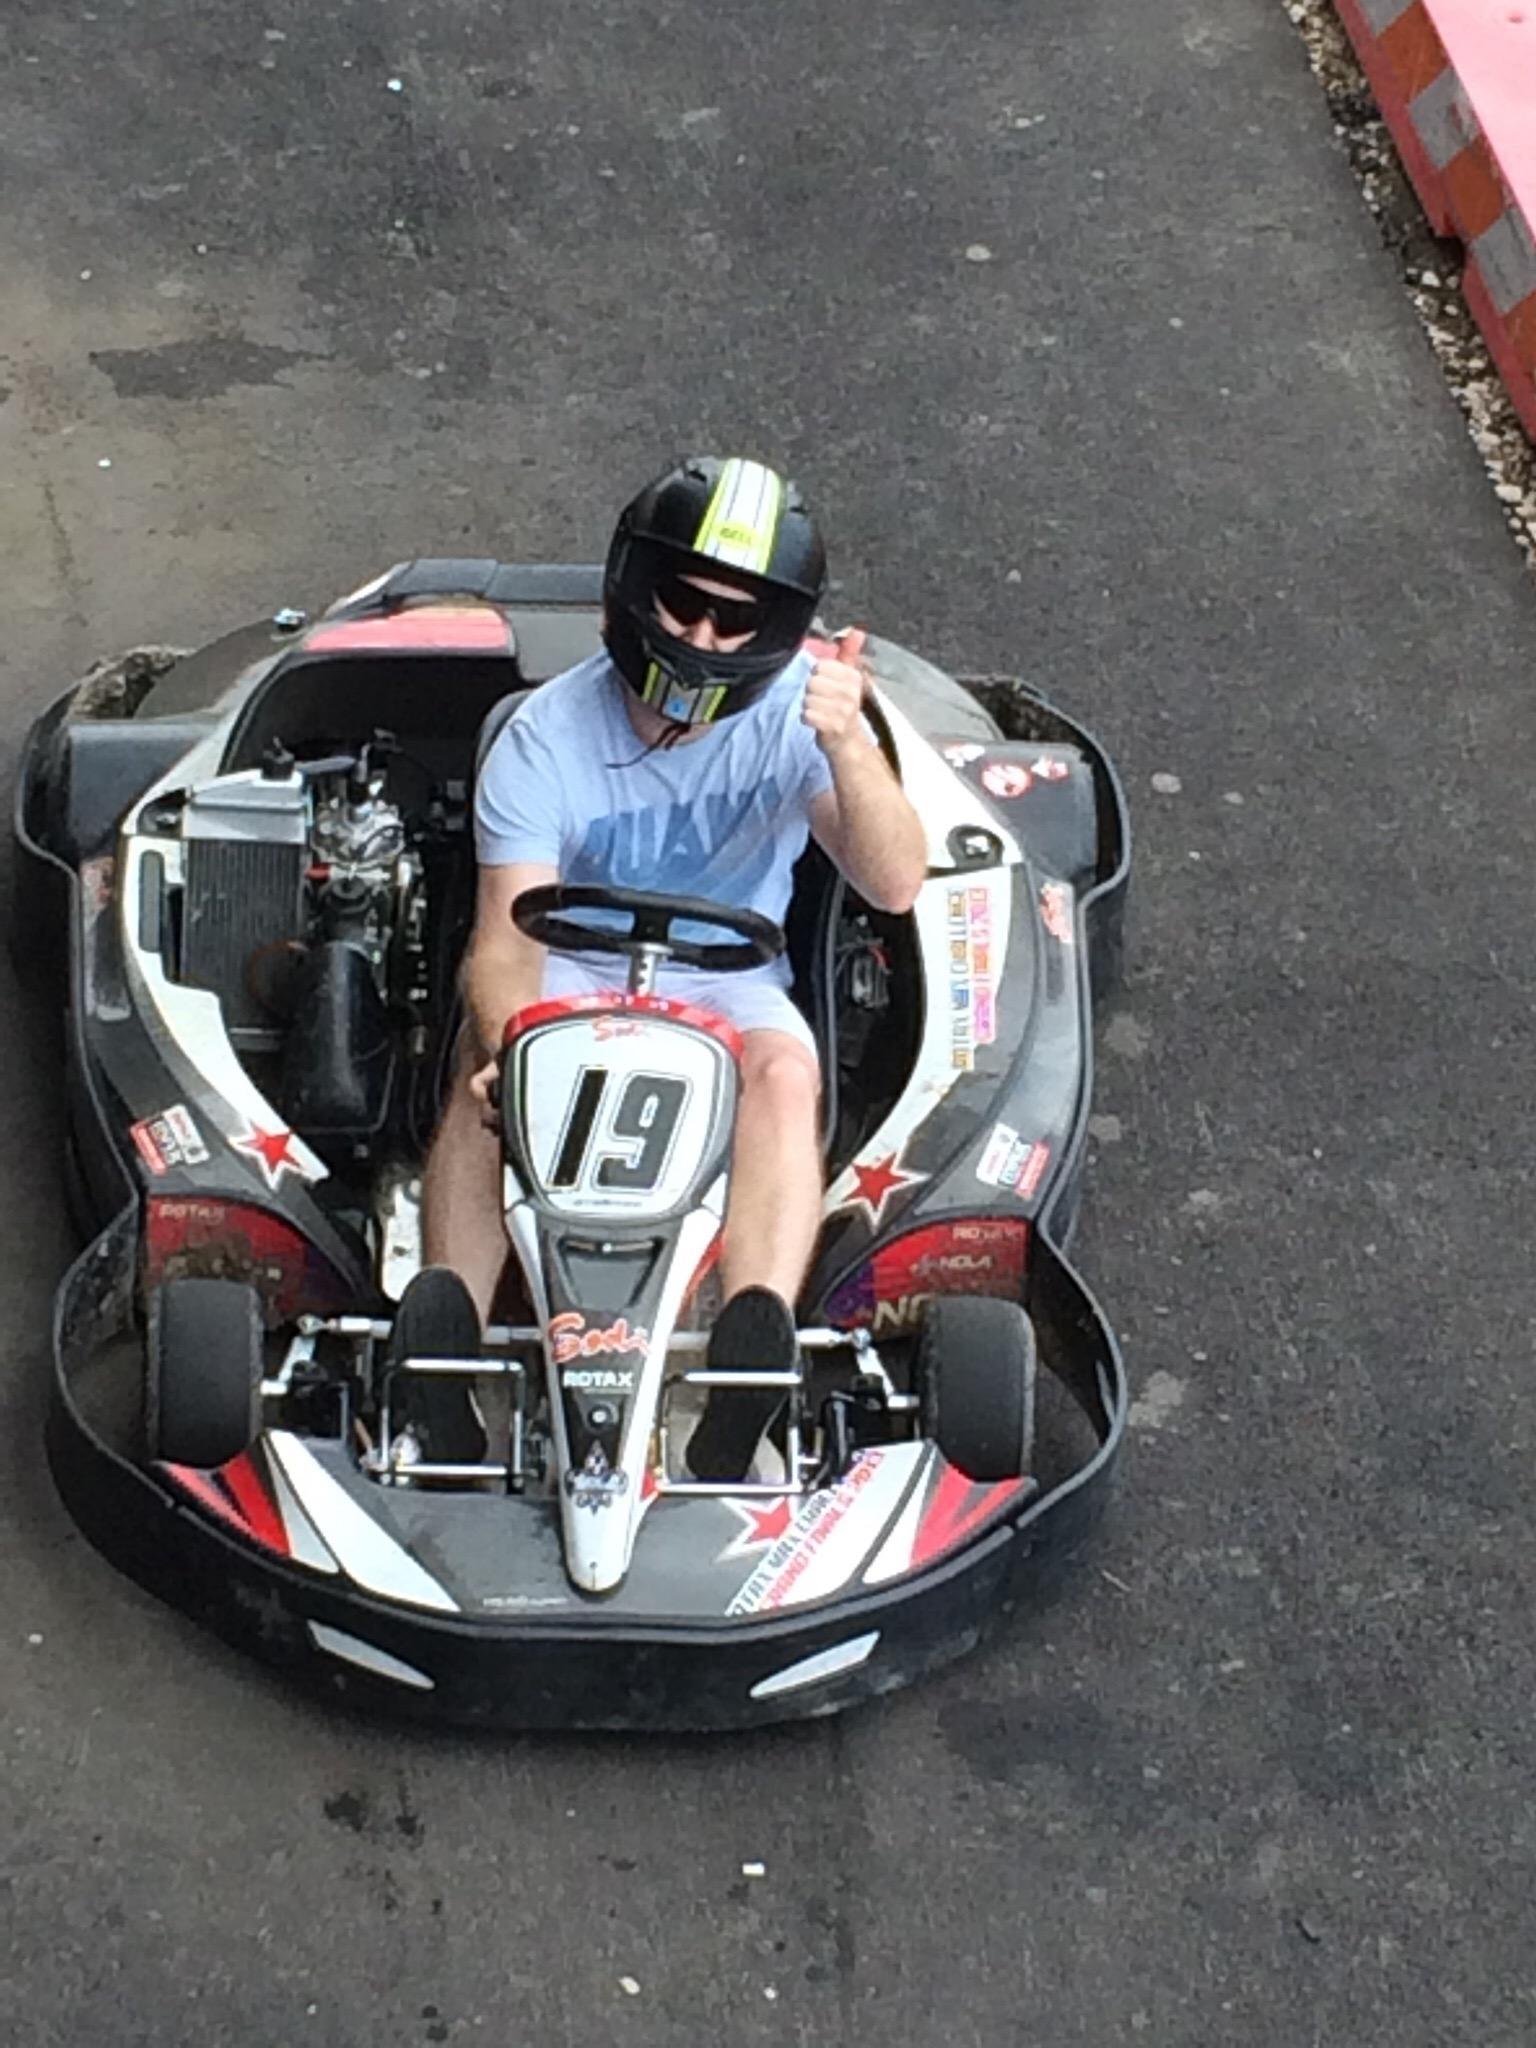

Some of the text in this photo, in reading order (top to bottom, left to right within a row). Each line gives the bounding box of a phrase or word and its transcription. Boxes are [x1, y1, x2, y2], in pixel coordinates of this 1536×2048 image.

[548, 1066, 692, 1193] 19
[548, 1311, 651, 1363] Sodi
[562, 1369, 634, 1388] ROTAX
